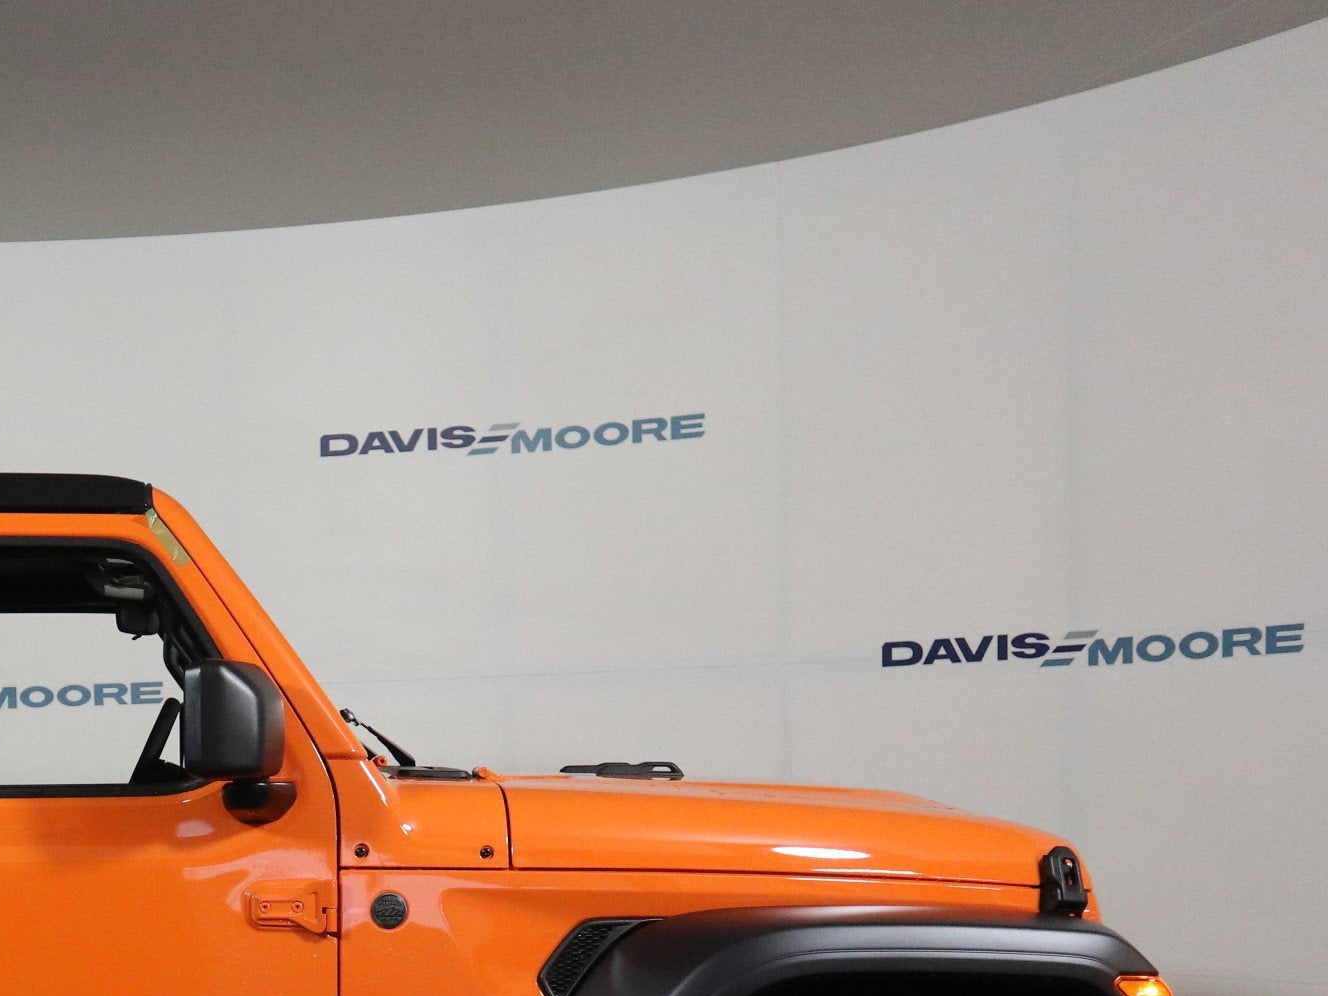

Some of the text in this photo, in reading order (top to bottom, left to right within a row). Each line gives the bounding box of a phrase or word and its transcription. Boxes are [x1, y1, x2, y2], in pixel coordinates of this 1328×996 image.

[320, 413, 706, 458] DAVIS MOORE
[881, 623, 1305, 668] DAVIS MOORE
